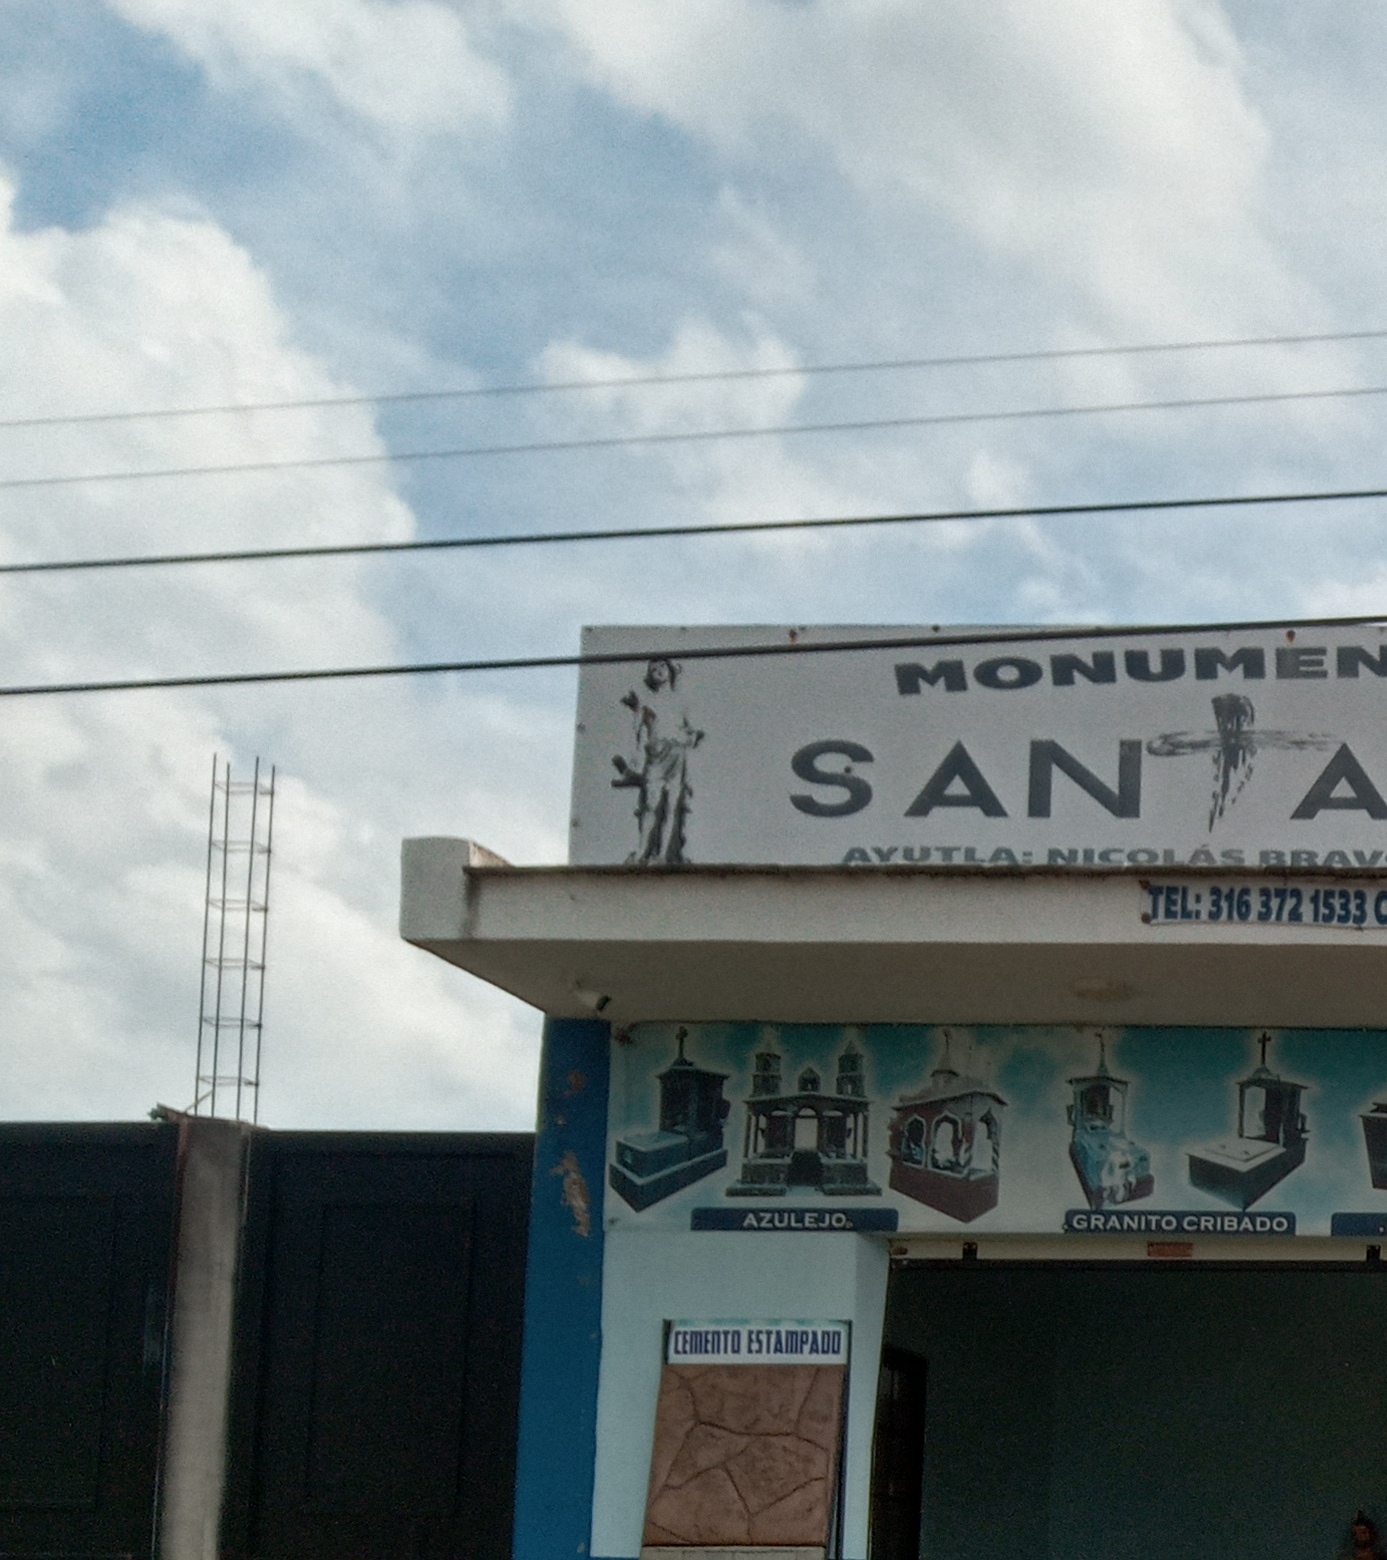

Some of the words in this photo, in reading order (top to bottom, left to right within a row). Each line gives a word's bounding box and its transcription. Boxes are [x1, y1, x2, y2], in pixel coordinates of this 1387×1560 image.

[841, 845, 1033, 866] AYUTLA:
[1047, 843, 1248, 867] NICOLÁS
[1148, 884, 1203, 921] TEL:
[1207, 886, 1252, 922] 316
[1257, 887, 1304, 923] 372
[1309, 888, 1368, 925] 1533
[742, 1212, 847, 1228] AZULEJO
[1072, 1214, 1178, 1231] GRANITO
[1182, 1214, 1289, 1233] CRIBADO
[674, 1330, 742, 1355] CEMENTO
[746, 1330, 842, 1355] ESTAMPADO
